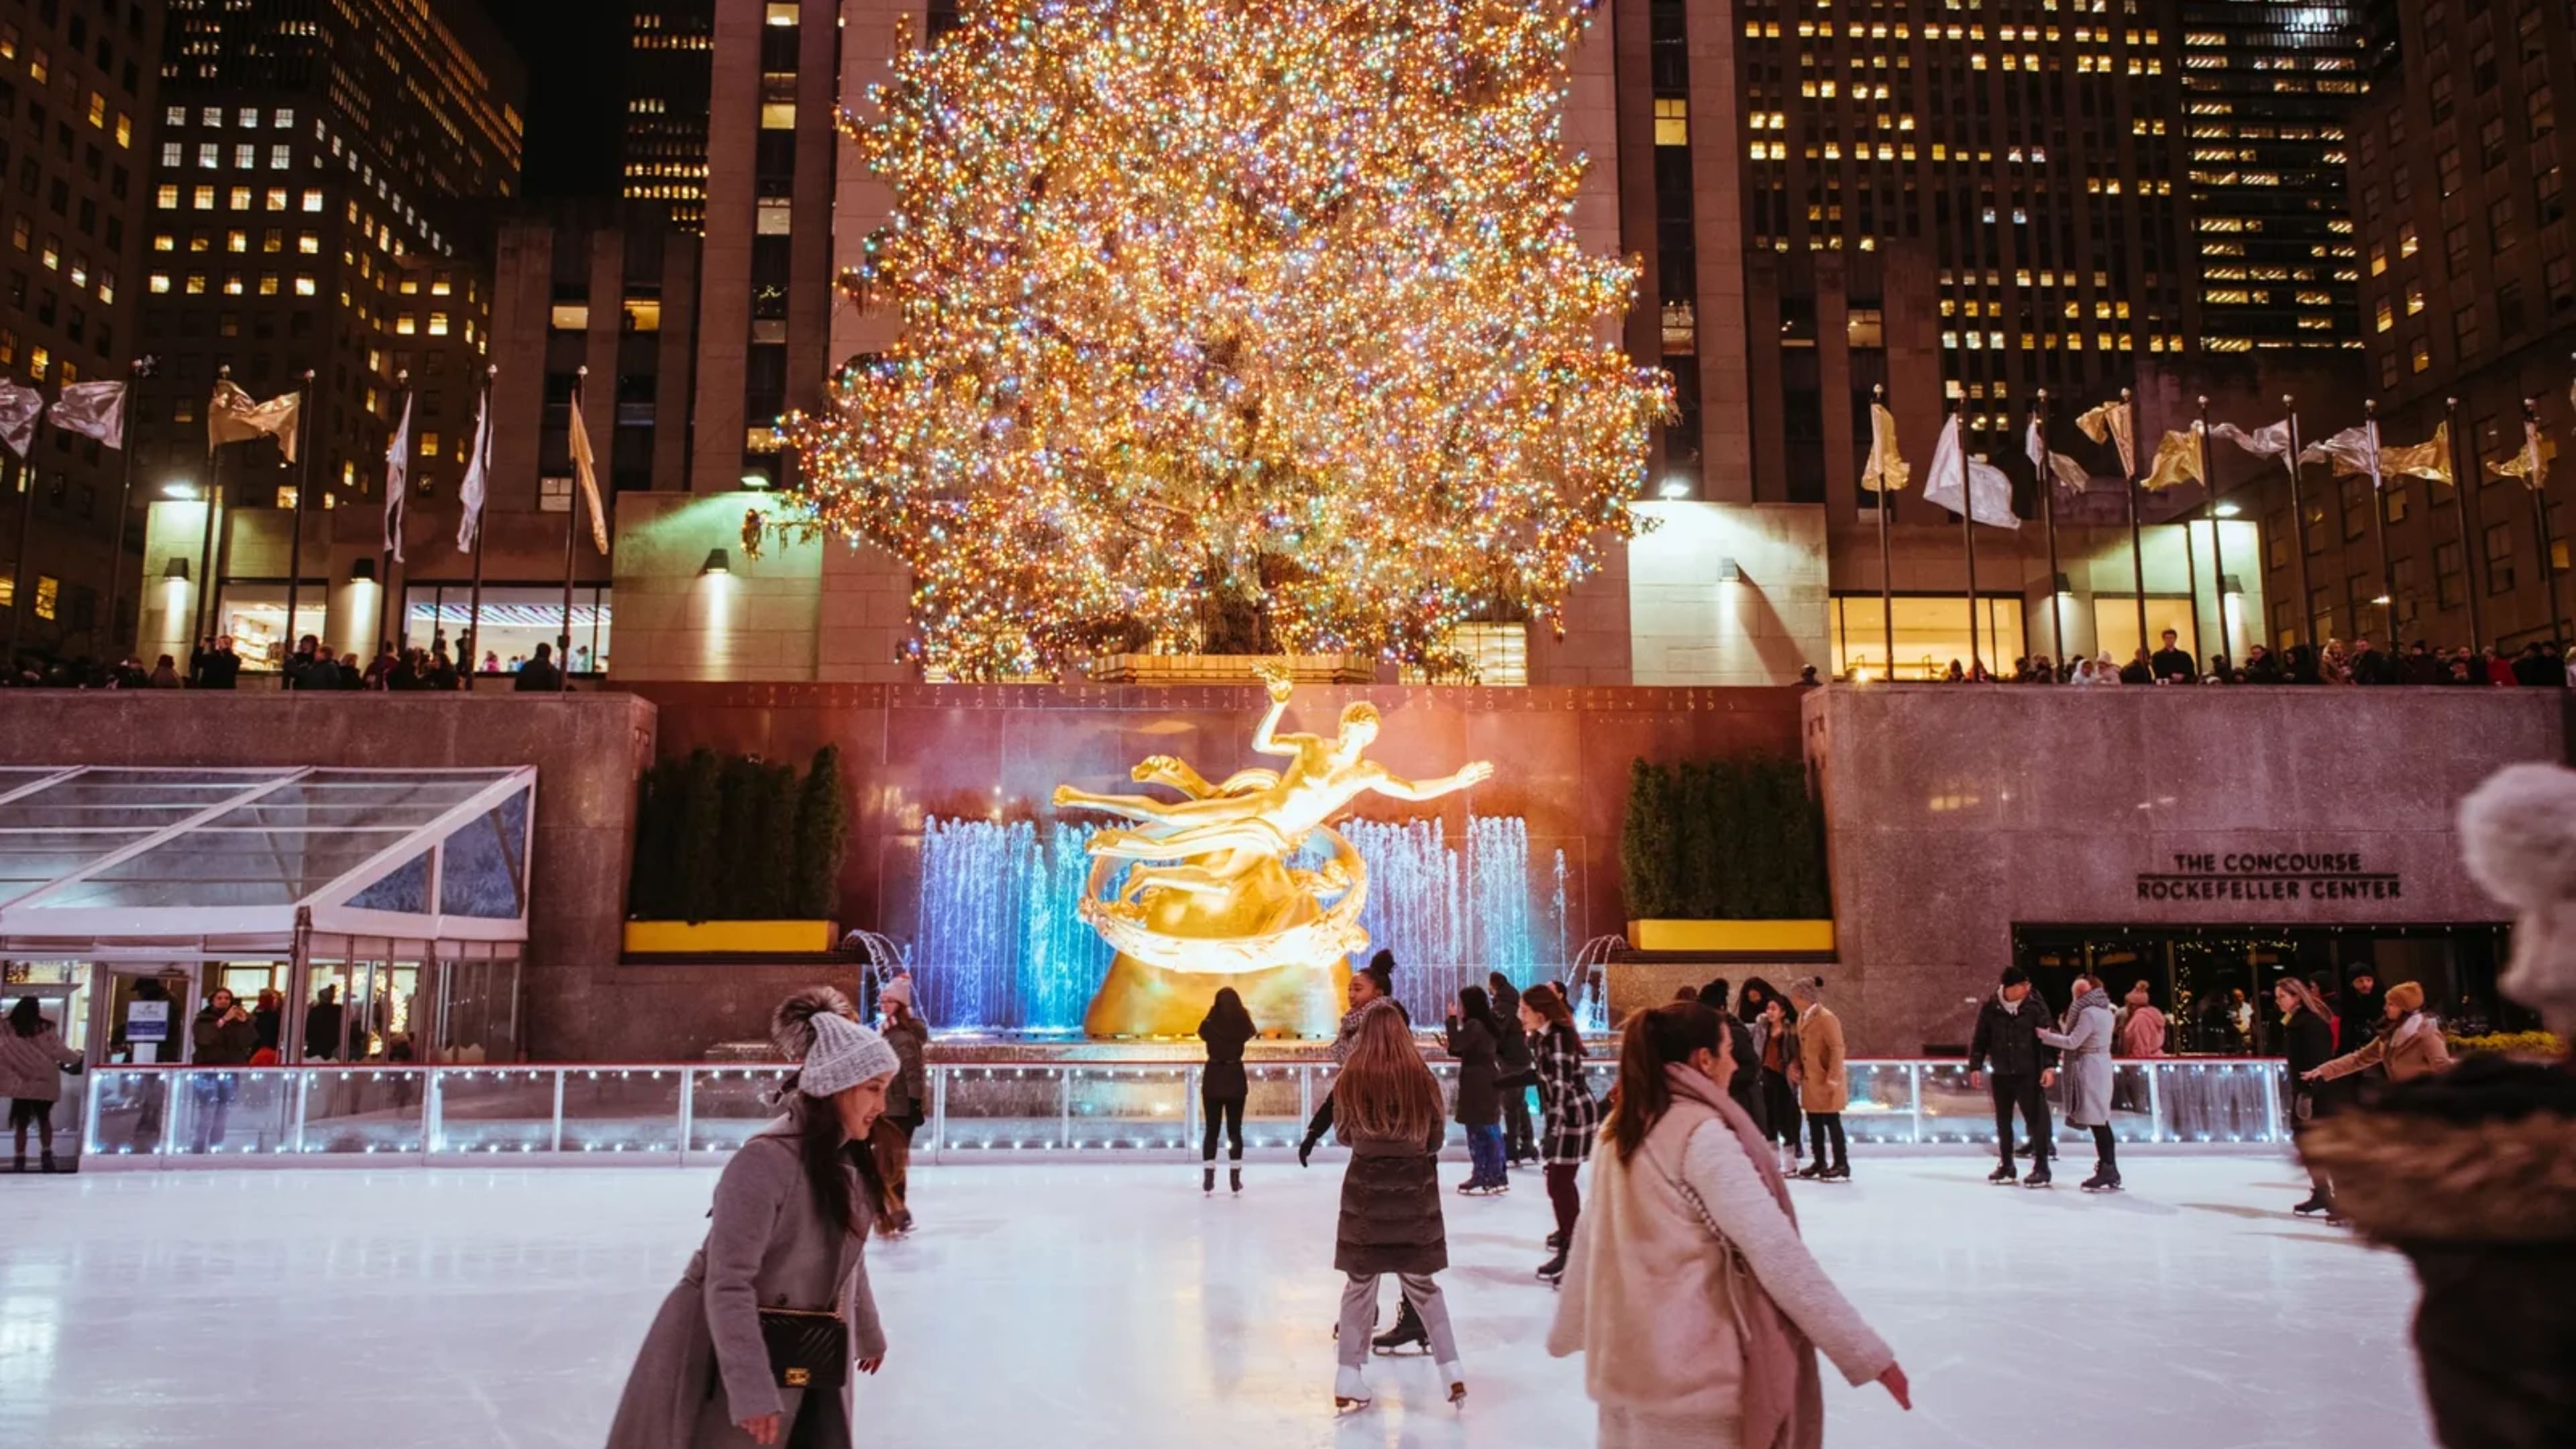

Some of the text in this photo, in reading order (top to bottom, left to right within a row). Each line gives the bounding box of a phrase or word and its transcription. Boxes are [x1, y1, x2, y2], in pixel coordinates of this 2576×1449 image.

[2174, 853, 2360, 871] THE CONCOURSE
[2137, 881, 2401, 900] ROCKEFELLER CENTER
